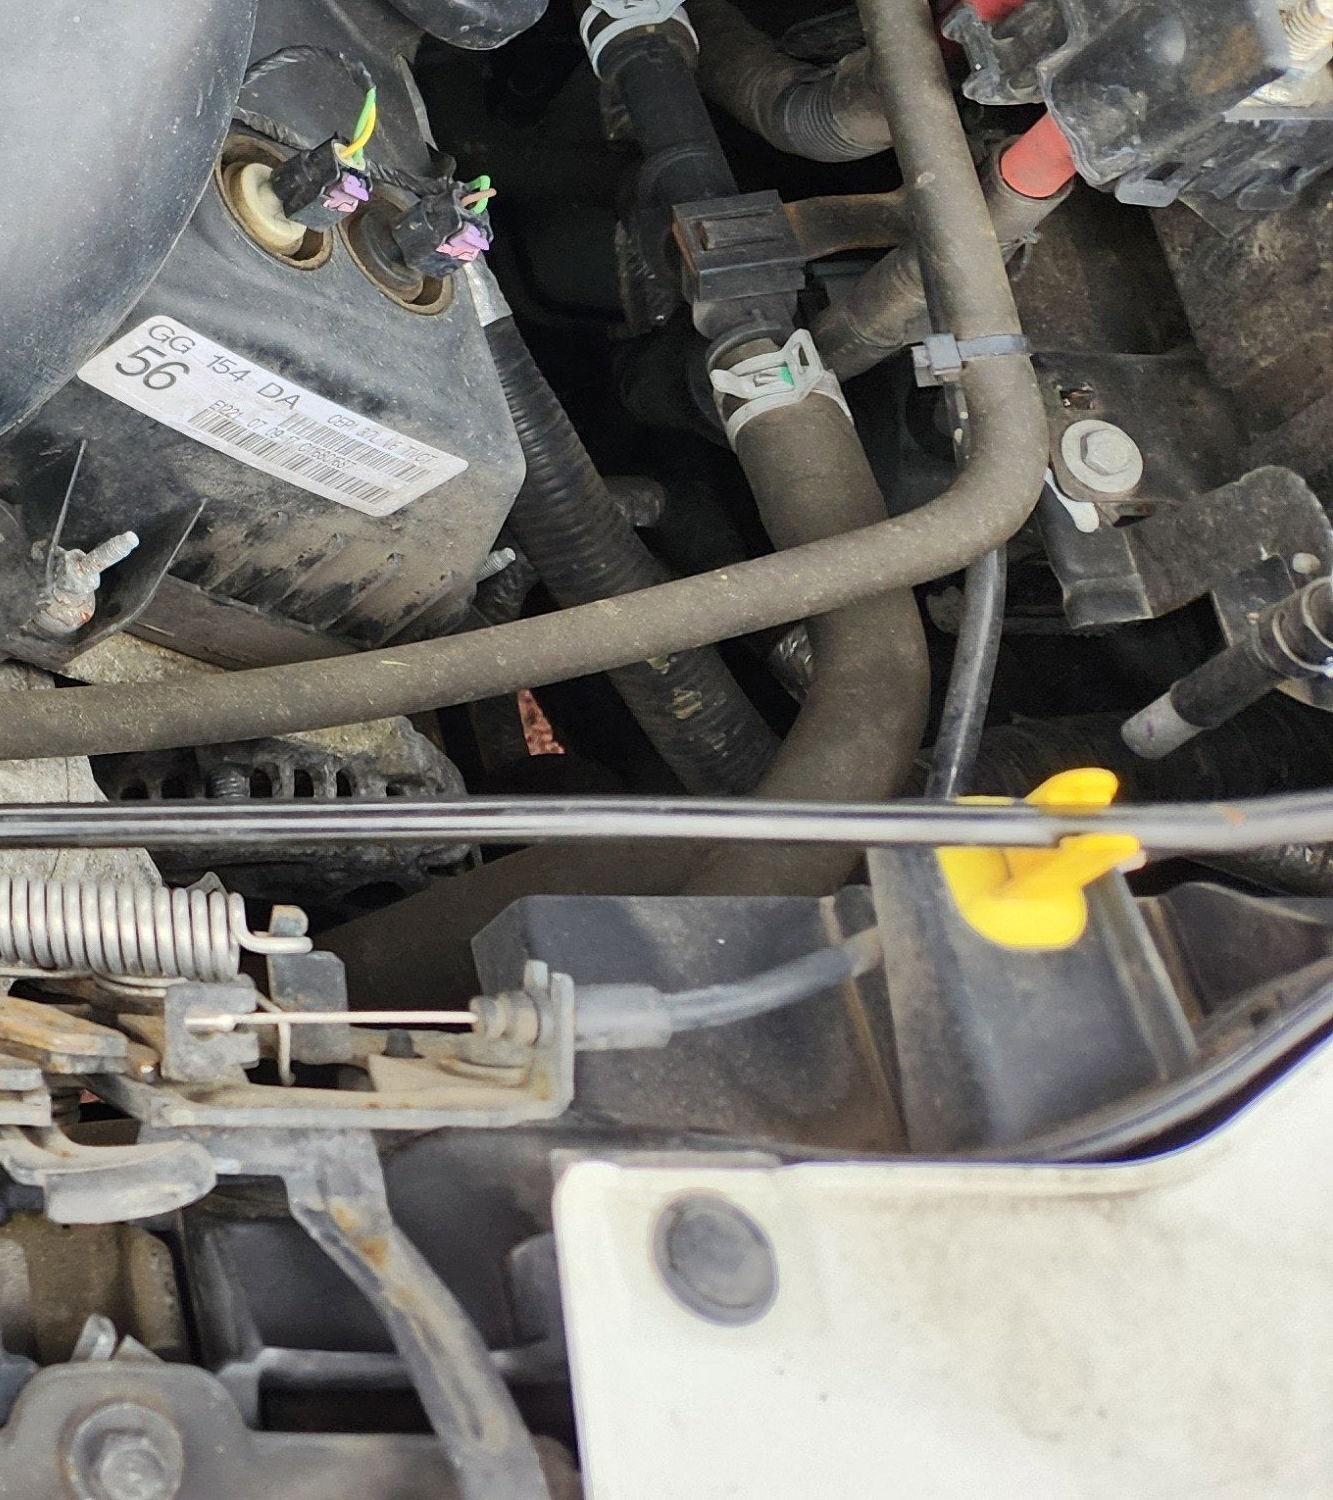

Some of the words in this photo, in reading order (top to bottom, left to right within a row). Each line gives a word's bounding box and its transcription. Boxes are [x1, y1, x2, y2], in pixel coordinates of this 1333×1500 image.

[115, 344, 191, 390] 56
[148, 324, 196, 355] GG
[206, 354, 251, 382] 154
[256, 381, 301, 410] DA
